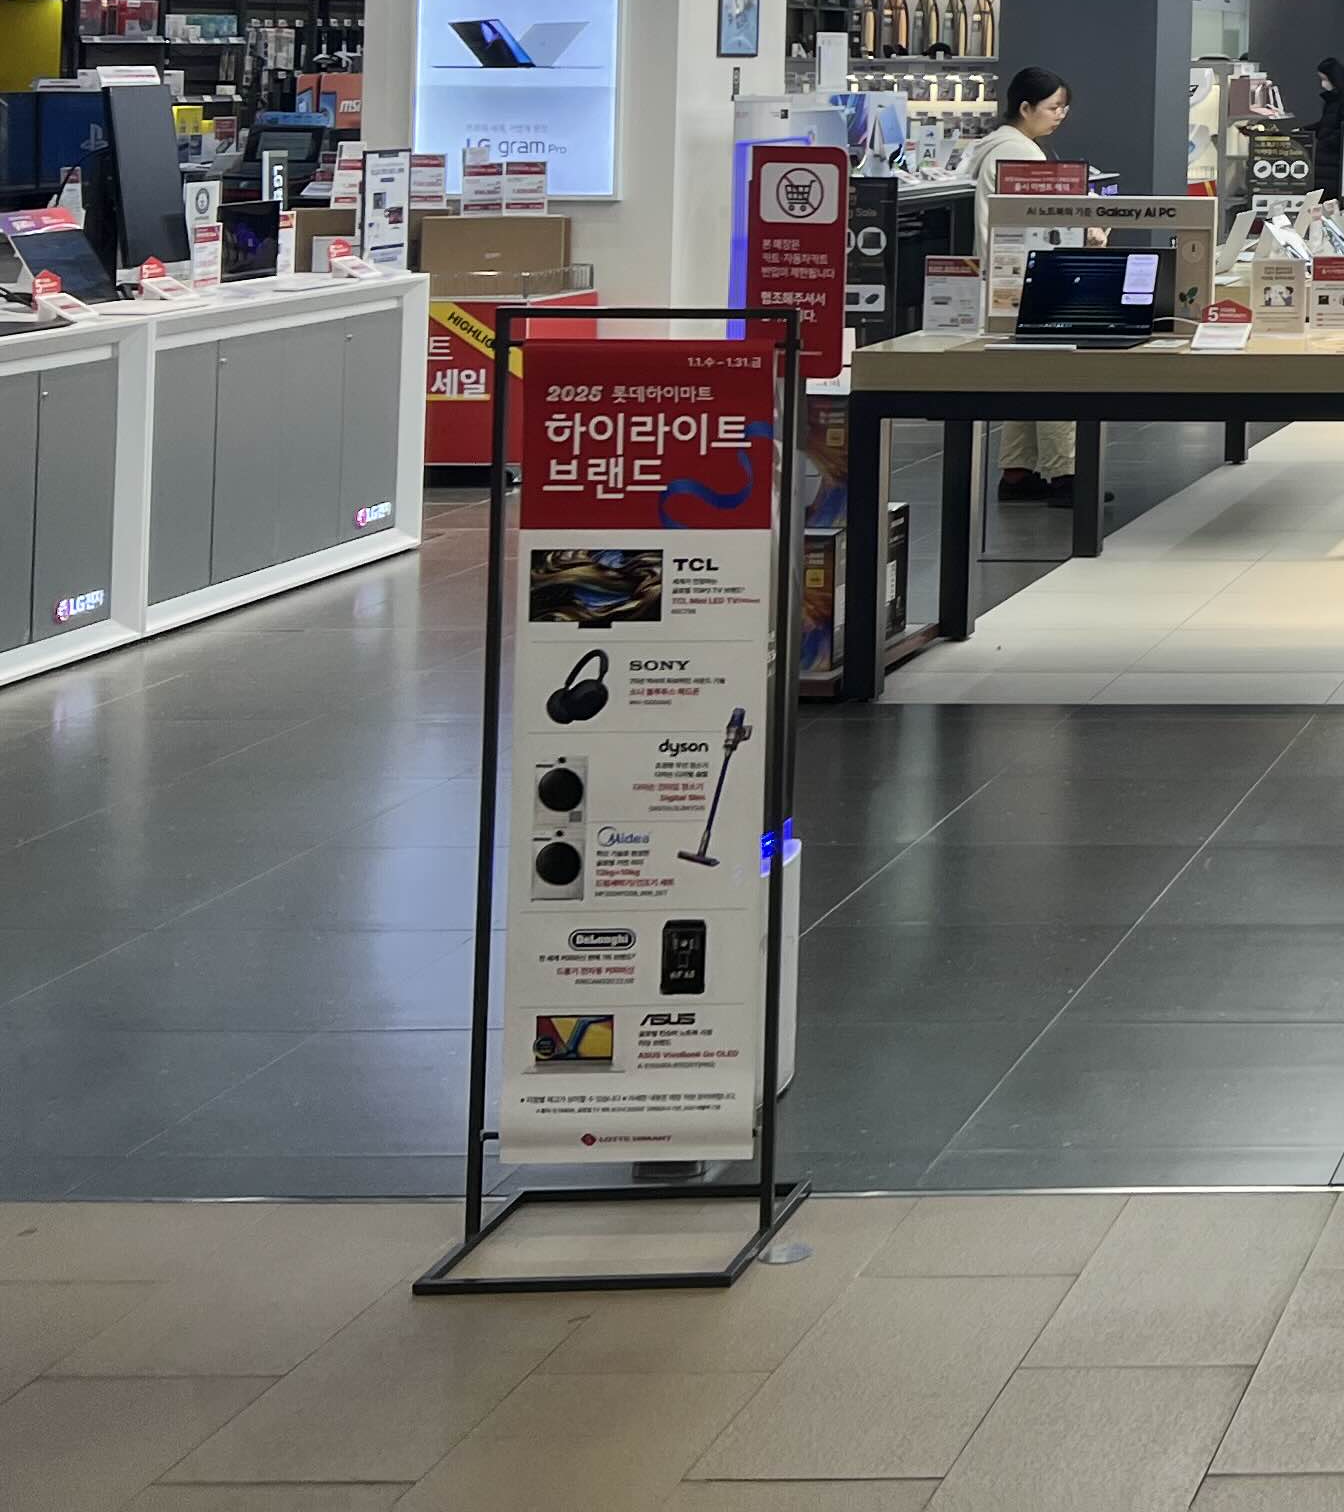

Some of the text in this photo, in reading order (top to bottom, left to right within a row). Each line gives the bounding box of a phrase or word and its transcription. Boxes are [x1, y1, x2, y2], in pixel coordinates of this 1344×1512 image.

[498, 139, 545, 158] gram
[548, 143, 567, 154] Pro
[1096, 207, 1142, 219] Galaxy
[1144, 207, 1157, 217] AI
[1159, 207, 1176, 217] PC
[430, 368, 486, 398] 세일
[545, 385, 715, 404] 2025 롯데하이마트
[545, 413, 752, 456] 하이라이트
[543, 455, 668, 499] 브랜드
[672, 558, 719, 571] TCL
[629, 660, 690, 671] SONY
[659, 739, 709, 756] dyson
[640, 1013, 696, 1026] ASUS
